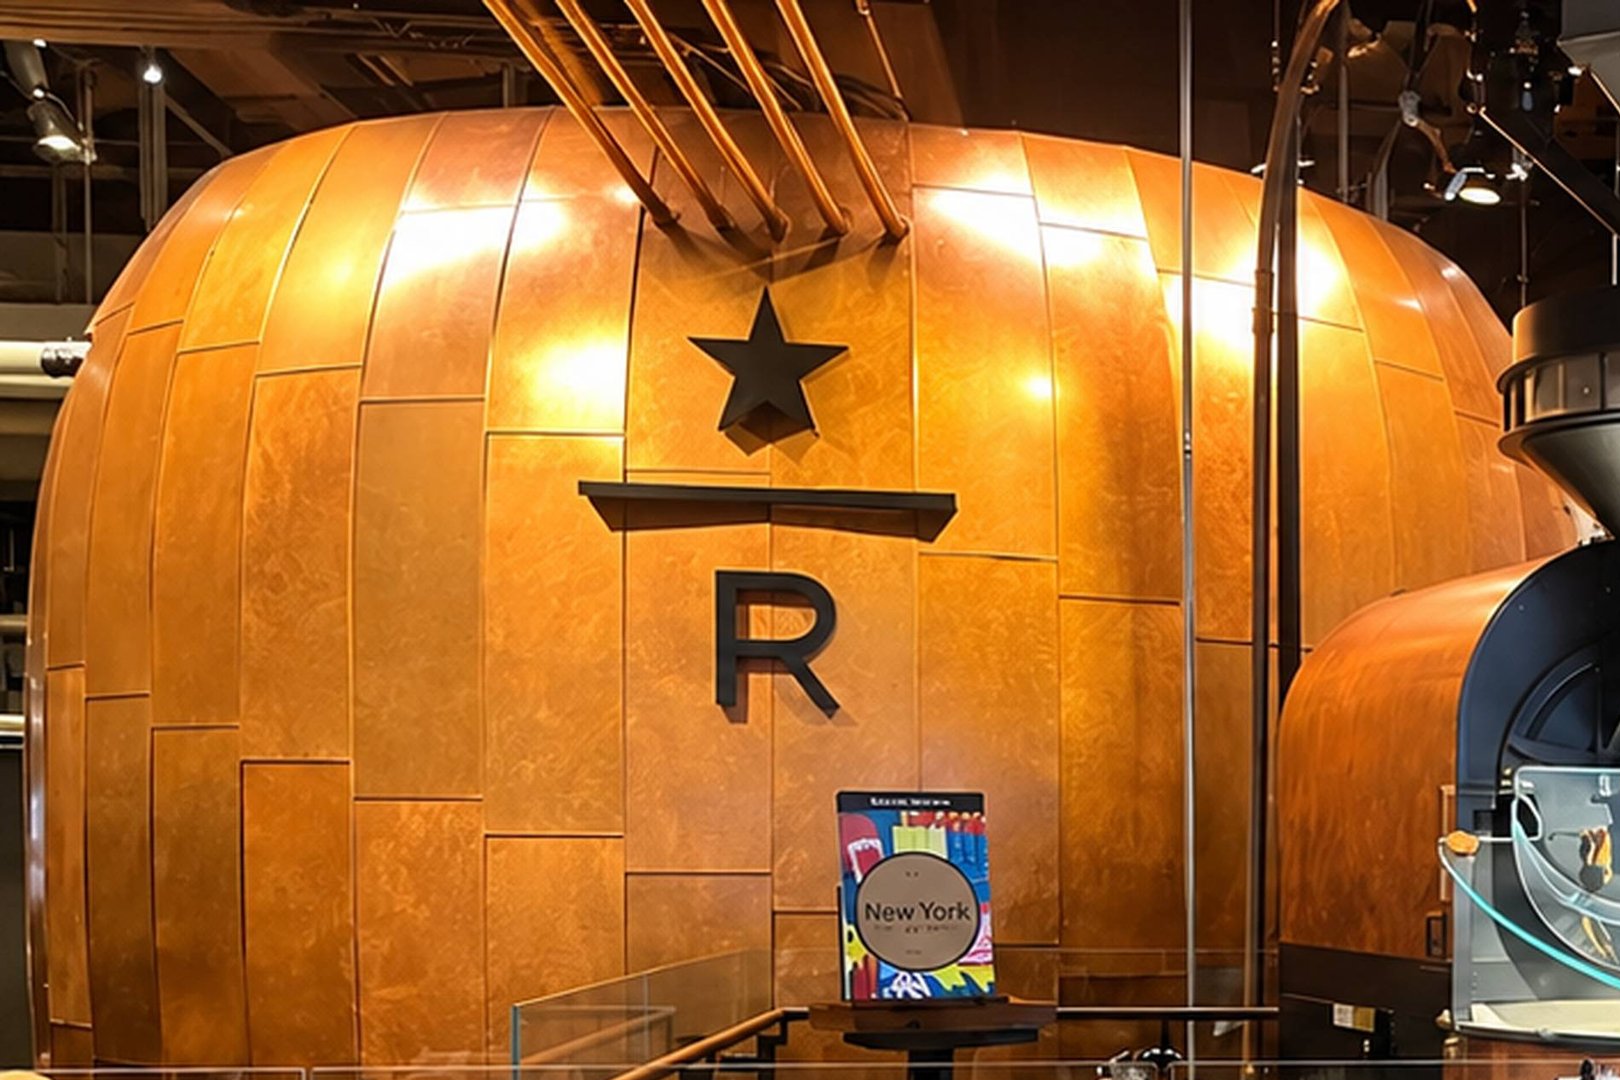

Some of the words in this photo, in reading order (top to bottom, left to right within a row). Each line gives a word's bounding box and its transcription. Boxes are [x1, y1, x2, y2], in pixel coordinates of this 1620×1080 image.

[715, 569, 841, 720] R
[865, 902, 915, 922] New
[918, 901, 971, 921] York
